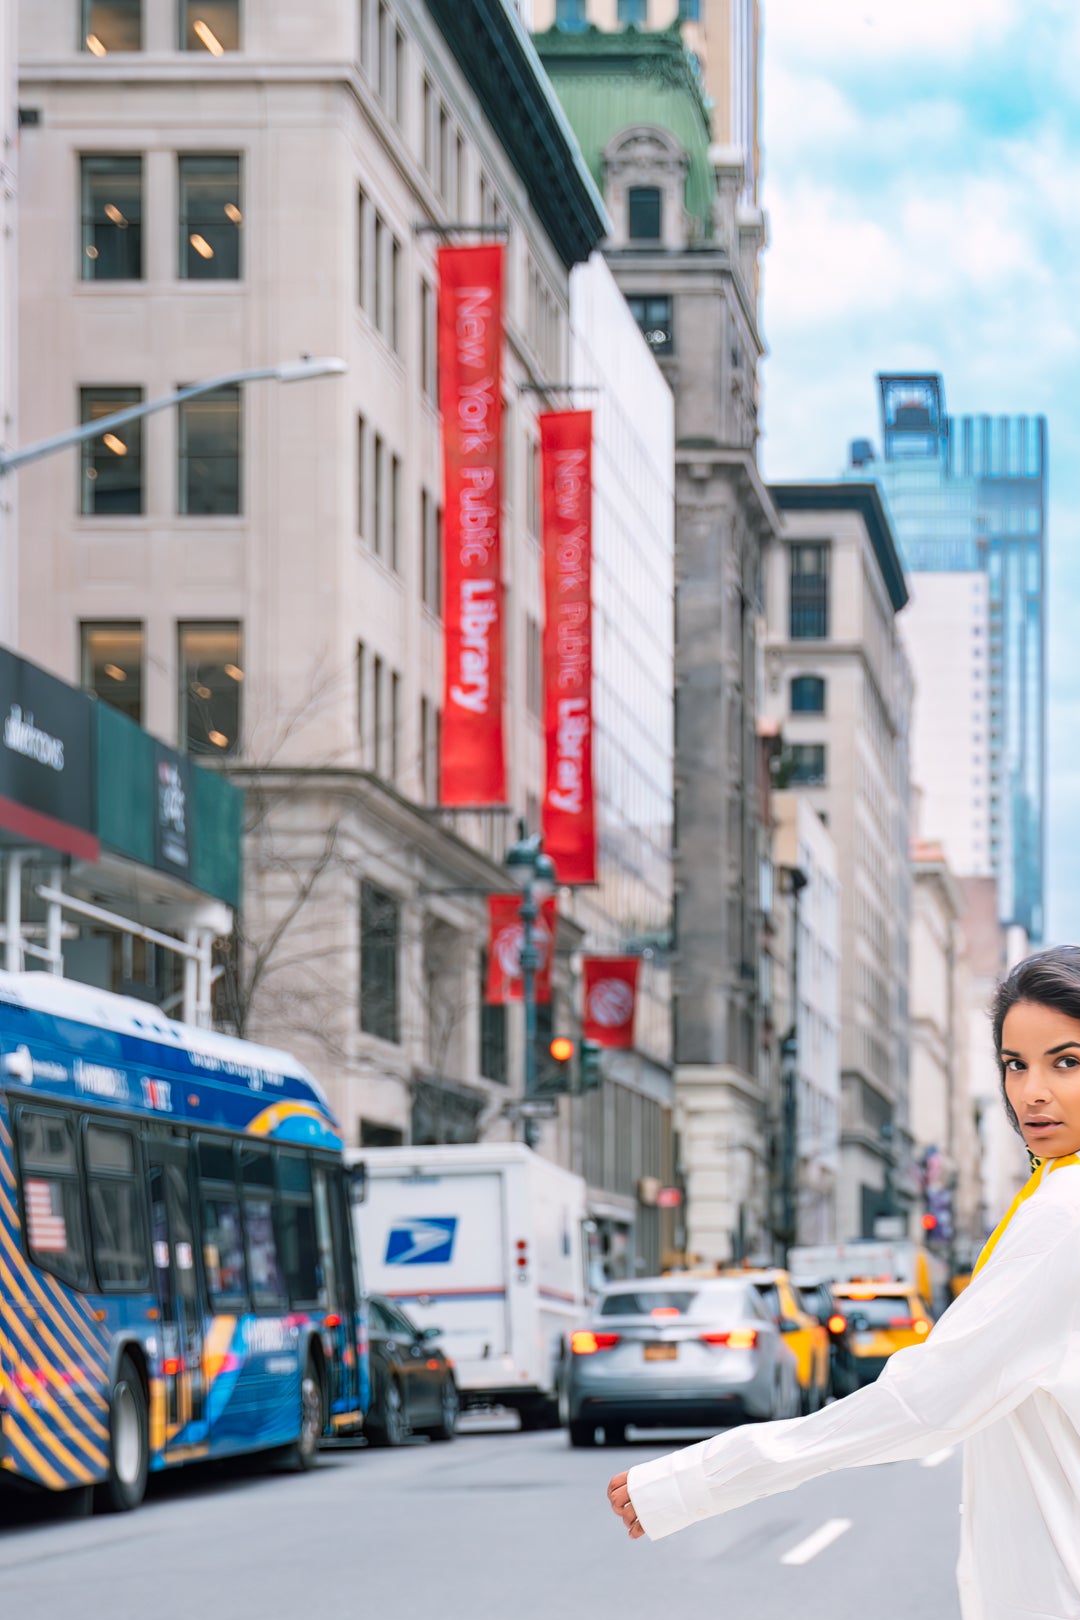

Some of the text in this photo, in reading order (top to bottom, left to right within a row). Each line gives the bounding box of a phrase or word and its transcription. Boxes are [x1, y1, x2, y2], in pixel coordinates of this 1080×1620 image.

[450, 286, 497, 714] New York Public Library
[548, 449, 589, 813] New York Public Library
